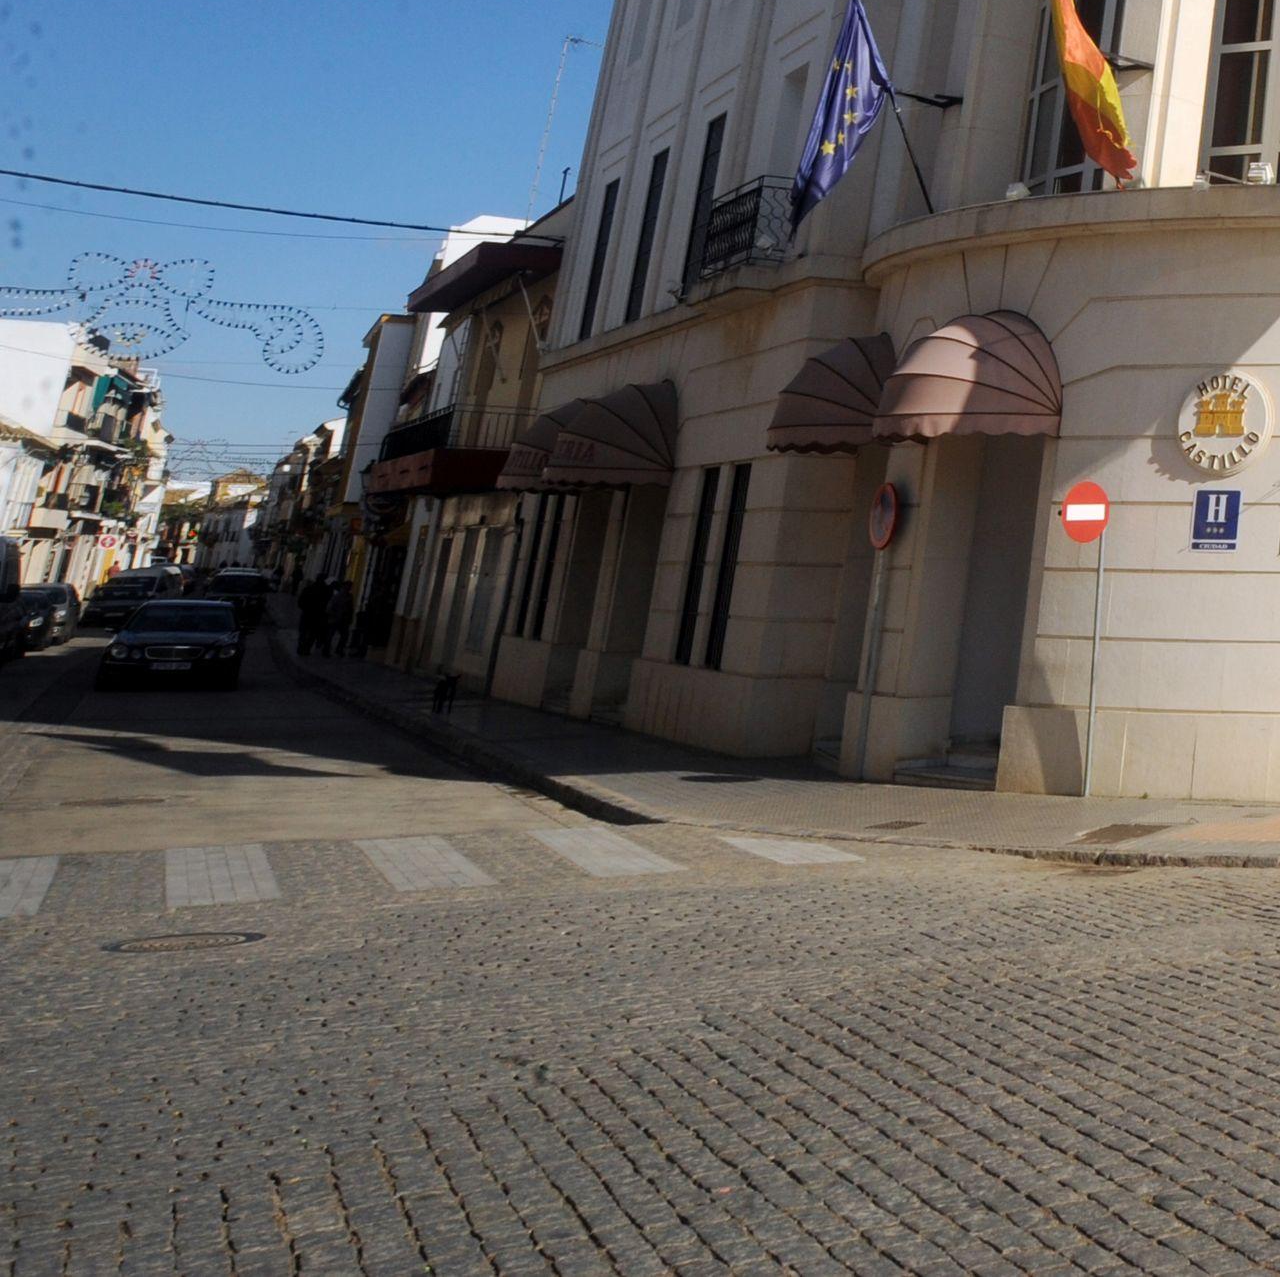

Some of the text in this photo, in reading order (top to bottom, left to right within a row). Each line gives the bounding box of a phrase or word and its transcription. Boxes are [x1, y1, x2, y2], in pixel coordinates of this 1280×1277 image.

[1197, 375, 1250, 399] HOTEL
[1180, 431, 1260, 469] CASTILLO
[1206, 494, 1229, 523] H
